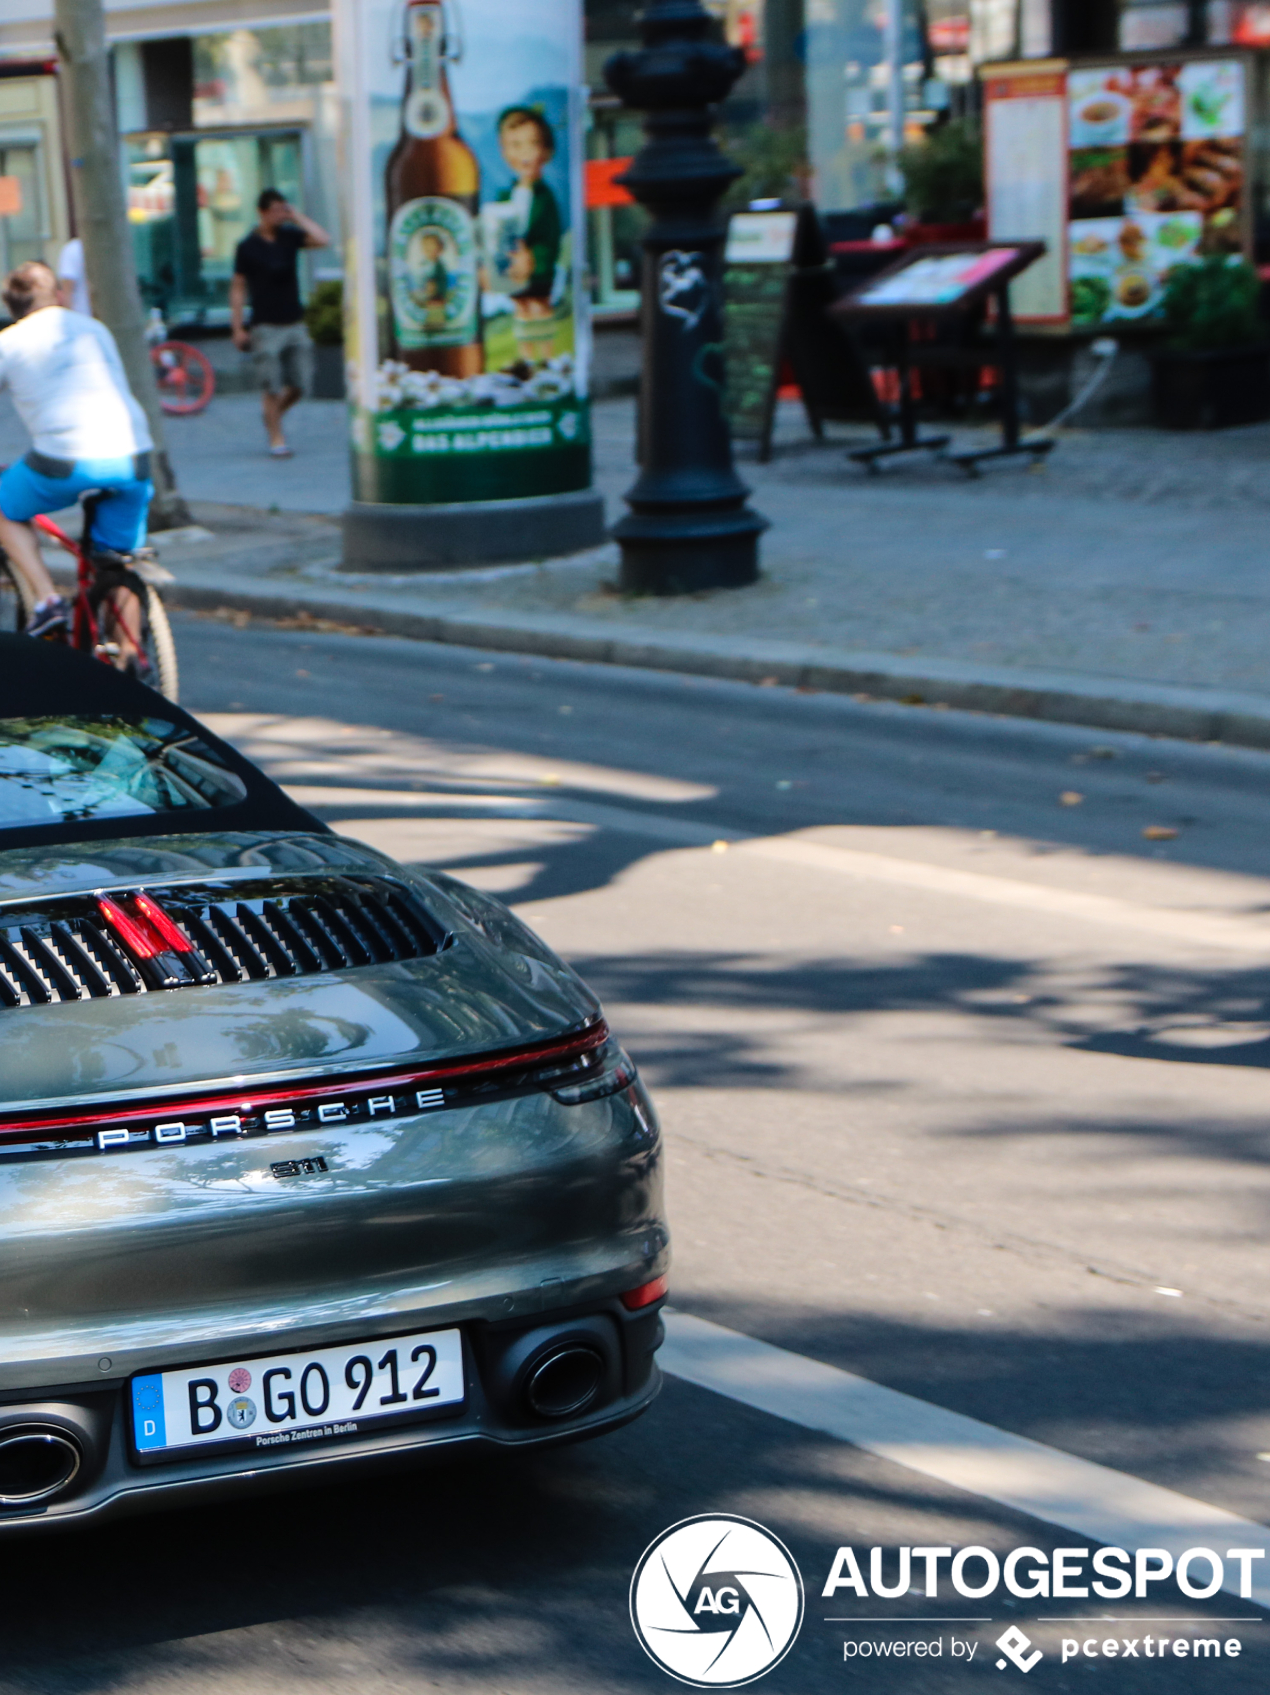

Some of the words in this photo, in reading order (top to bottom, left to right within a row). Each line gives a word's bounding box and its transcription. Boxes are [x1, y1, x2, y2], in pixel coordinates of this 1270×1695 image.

[98, 1088, 445, 1149] PORSCHE
[270, 1156, 329, 1178] 911
[188, 1377, 222, 1435] B
[262, 1362, 330, 1423] GO
[344, 1344, 440, 1411] 912
[144, 1420, 156, 1437] D
[256, 1433, 290, 1447] Porsche
[290, 1427, 324, 1441] Zentren
[324, 1425, 332, 1435] in
[333, 1421, 358, 1434] Berlin
